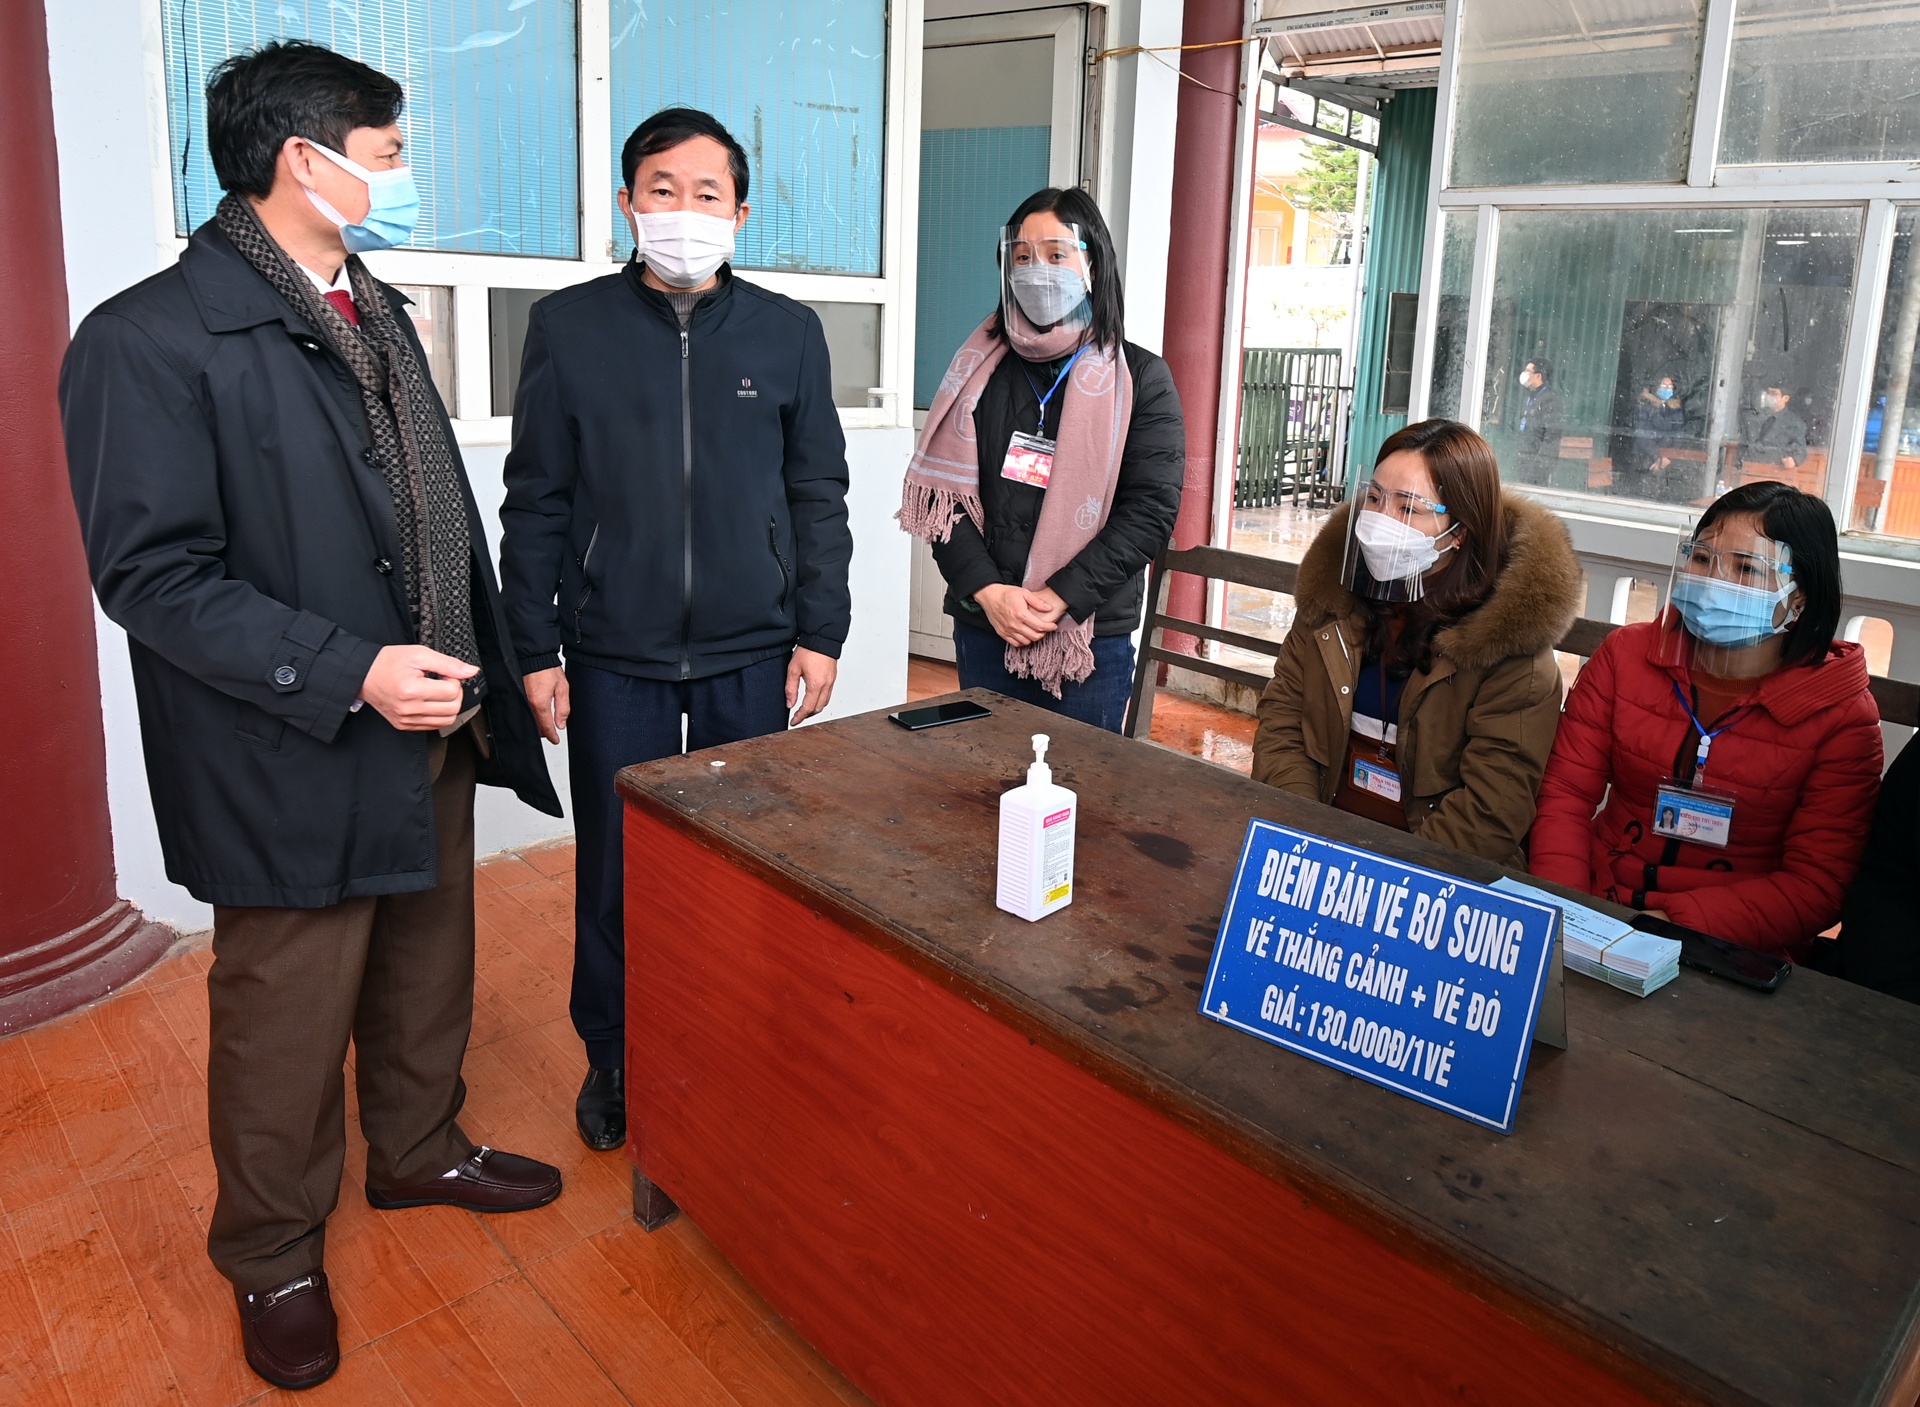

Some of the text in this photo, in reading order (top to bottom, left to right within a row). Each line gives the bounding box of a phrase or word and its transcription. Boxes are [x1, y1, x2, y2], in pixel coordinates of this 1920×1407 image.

[1257, 839, 1525, 976] ĐIỂM BÁN VÉ BỔ SUNG
[1245, 915, 1502, 1038] VÉ THẮNG CẢNH + VÉ ĐÒ
[1307, 1001, 1456, 1088] 130.000Đ/1VÉ
